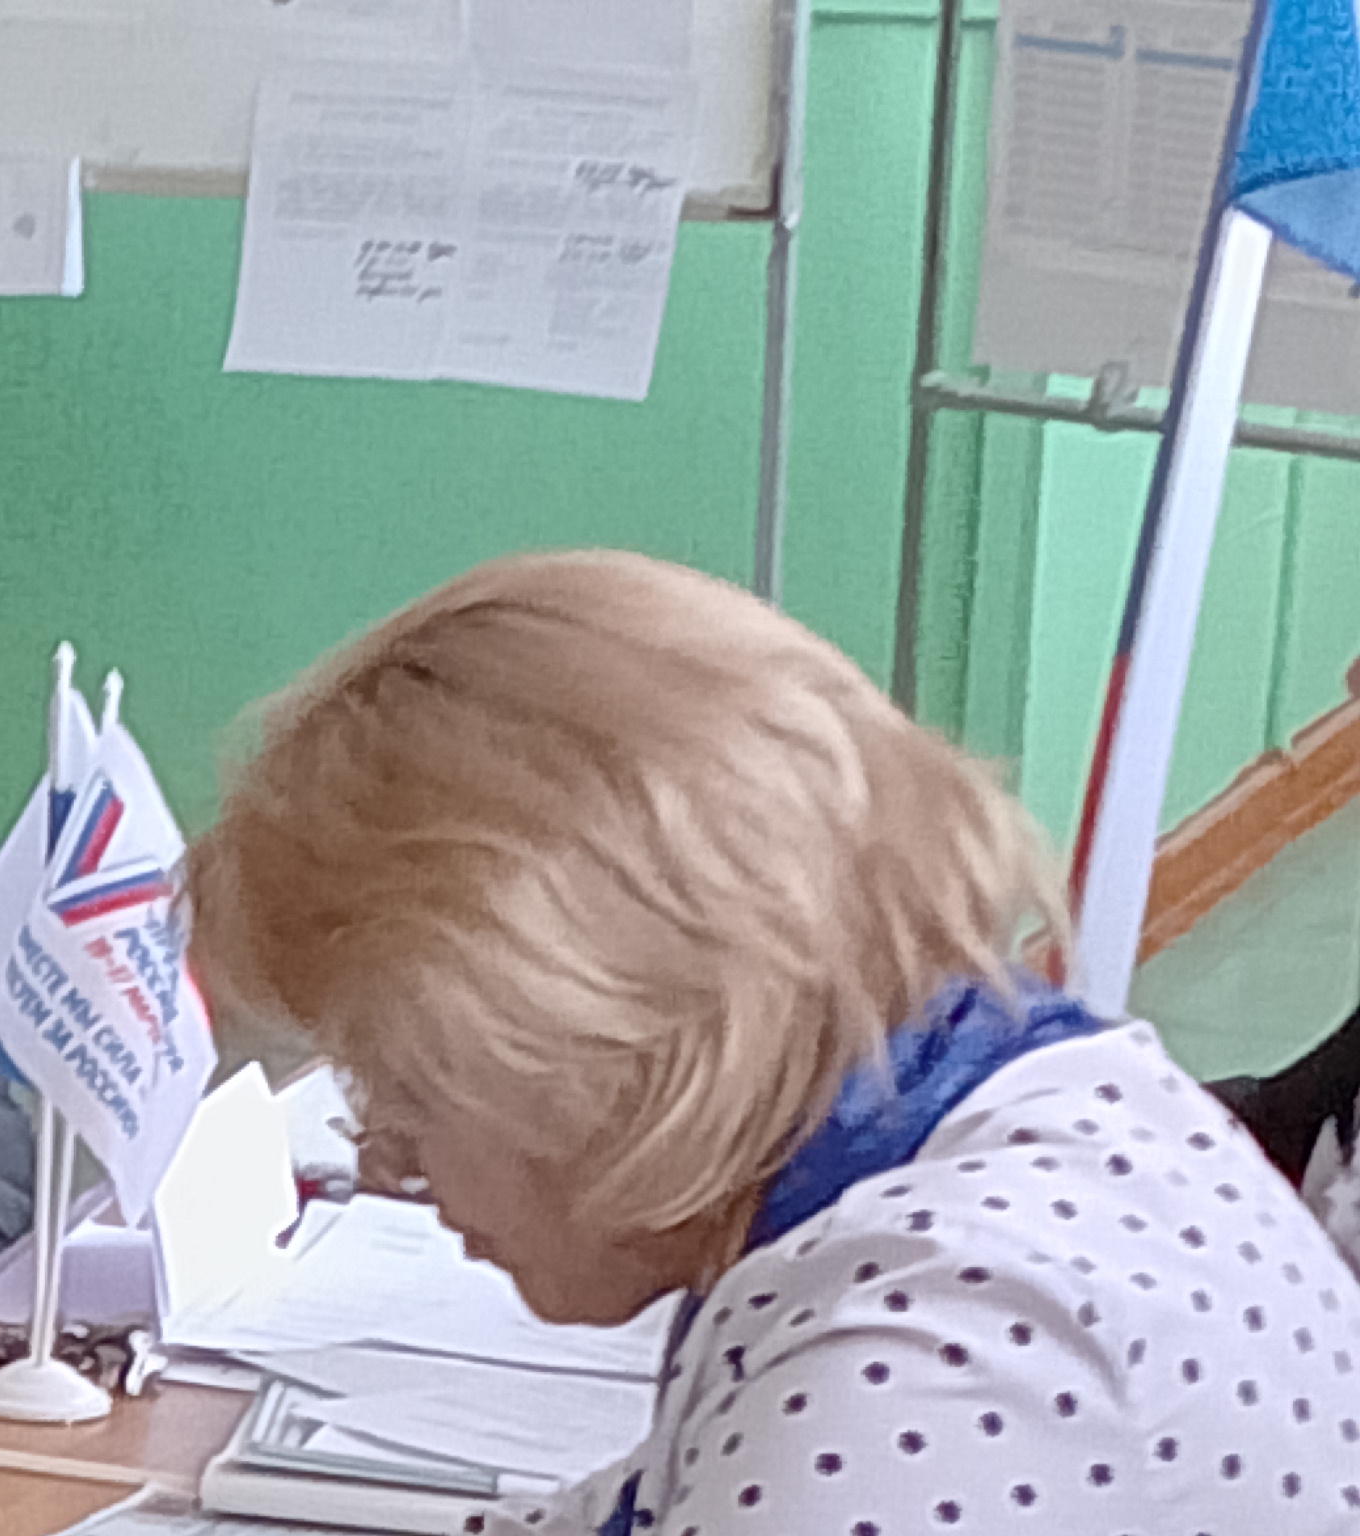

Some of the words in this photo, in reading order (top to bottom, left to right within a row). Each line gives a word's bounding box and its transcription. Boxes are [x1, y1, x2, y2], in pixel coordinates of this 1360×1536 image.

[41, 1016, 74, 1054] ЗА
[60, 986, 102, 1032] МЫ
[91, 1024, 143, 1086] СИЛА
